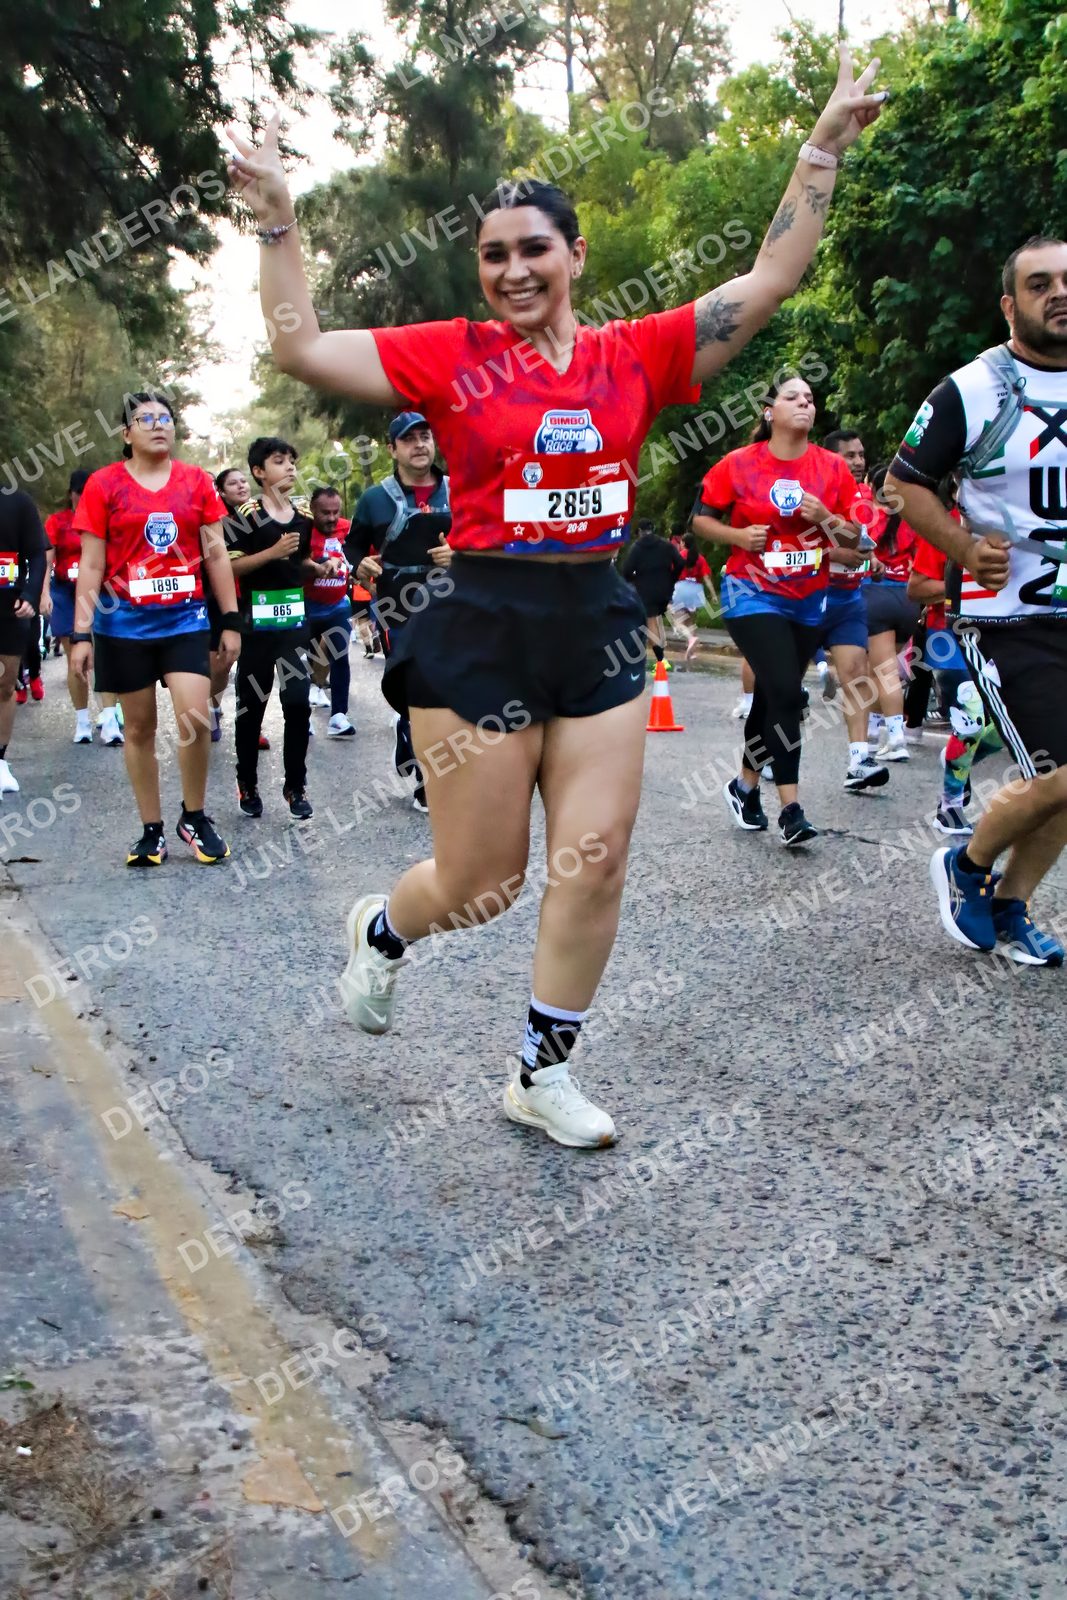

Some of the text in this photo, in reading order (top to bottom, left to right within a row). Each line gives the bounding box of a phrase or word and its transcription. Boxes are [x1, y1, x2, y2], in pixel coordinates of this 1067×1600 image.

[549, 417, 585, 425] BIMBO
[552, 429, 586, 441] Global
[545, 440, 573, 452] Race
[548, 487, 602, 518] 2859
[785, 552, 807, 565] 3121
[152, 578, 179, 593] 1896
[273, 604, 292, 617] 865
